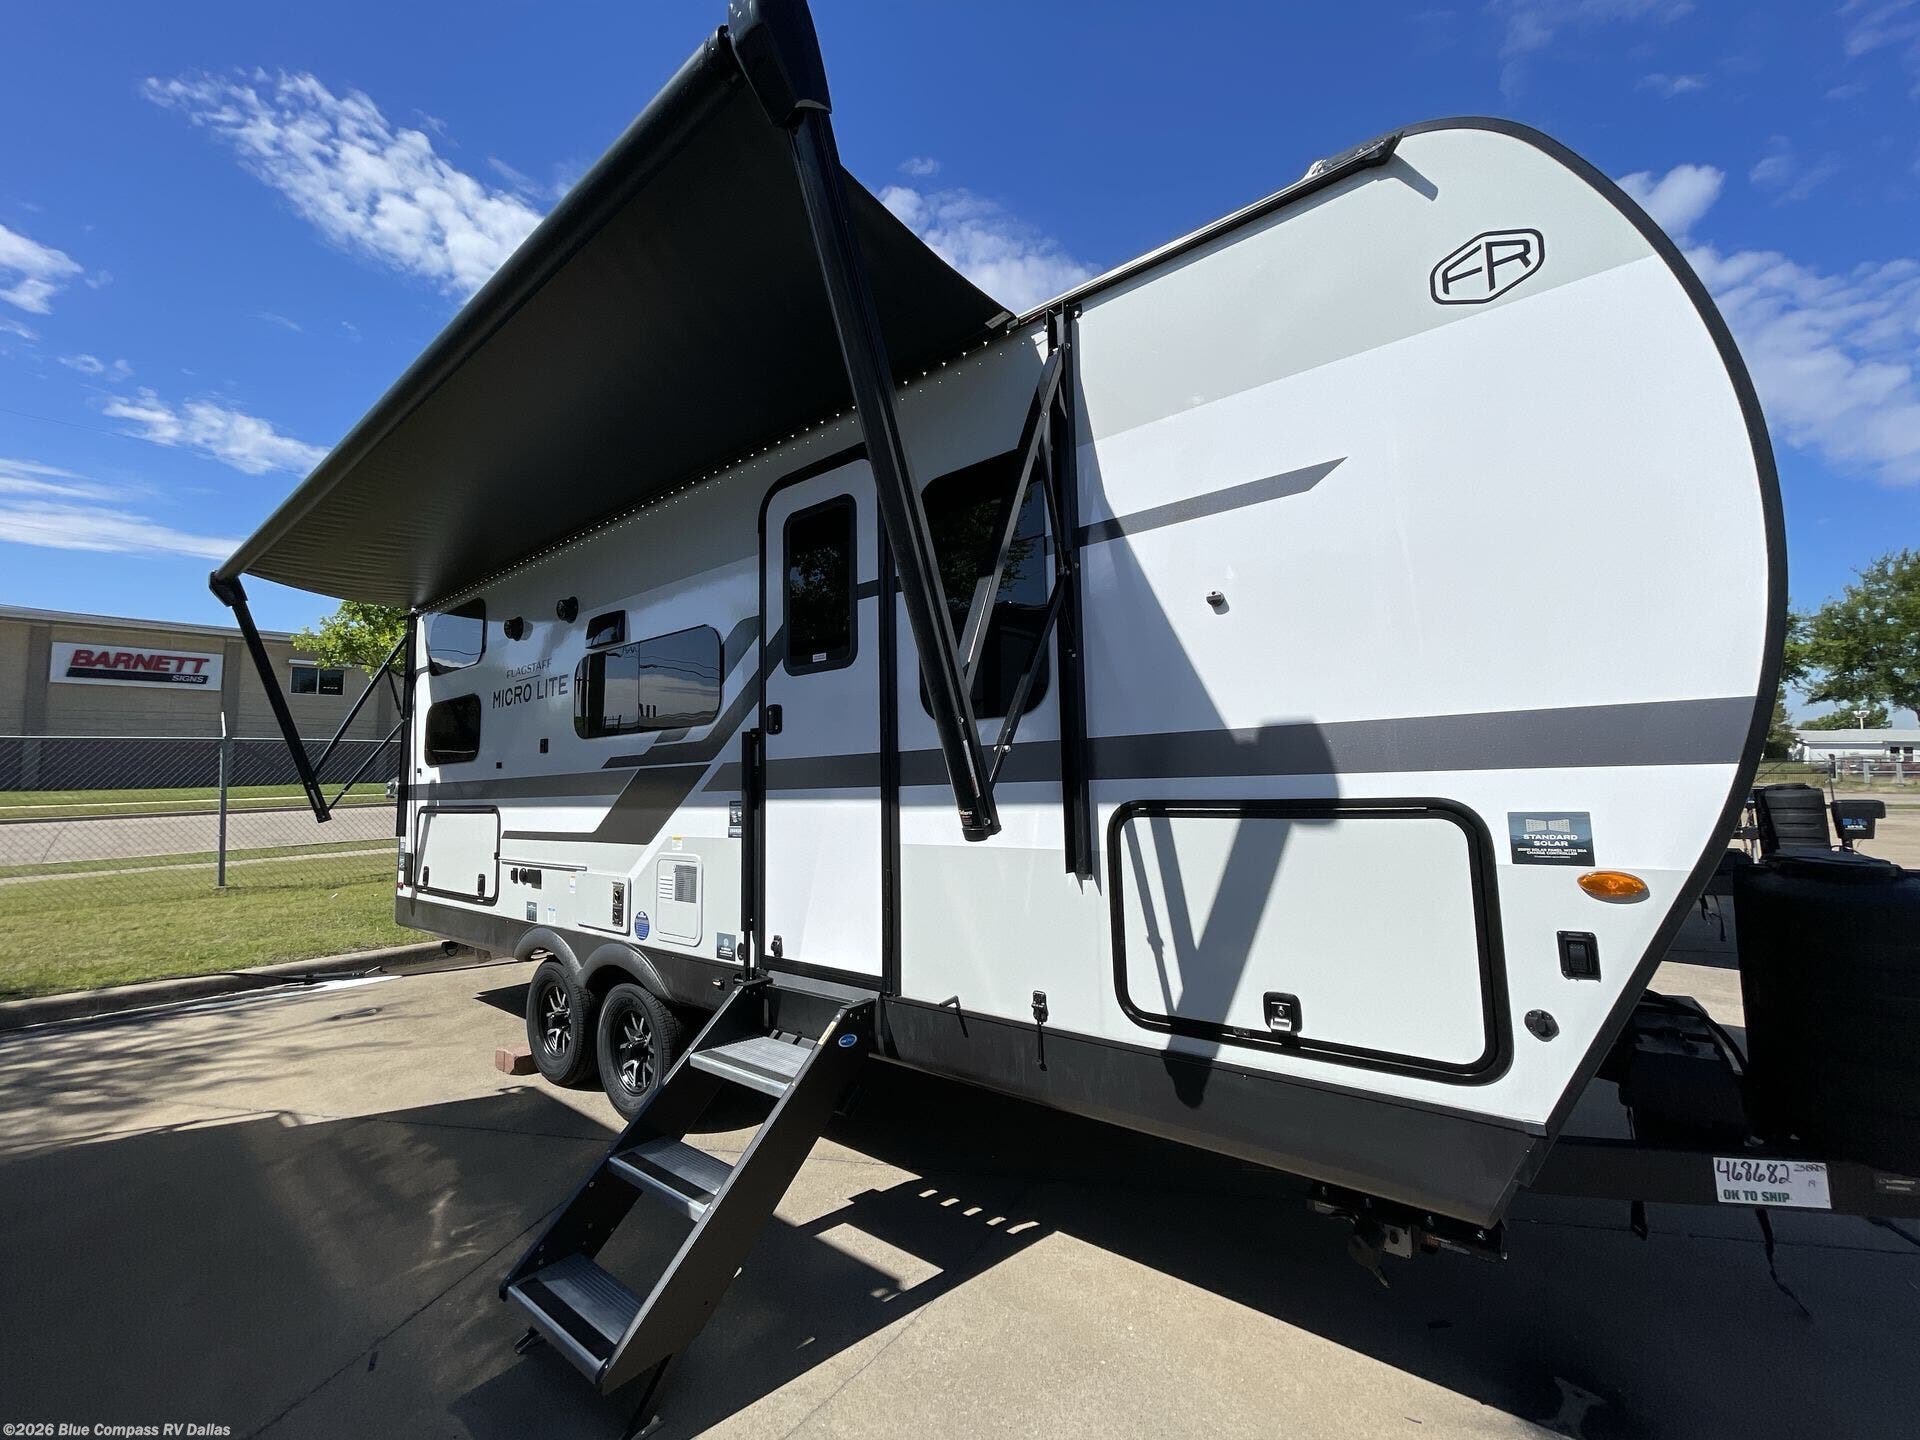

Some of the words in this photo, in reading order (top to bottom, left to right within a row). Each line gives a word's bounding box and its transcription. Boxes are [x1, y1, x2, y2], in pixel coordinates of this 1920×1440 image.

[70, 649, 210, 674] BARNETT
[506, 658, 552, 679] FLAGSTAFF
[171, 674, 204, 683] SIGNS
[492, 683, 532, 709] MICRO
[536, 673, 569, 700] LITE
[1716, 1159, 1793, 1184] 468682
[1723, 1189, 1741, 1200] OK
[1743, 1190, 1758, 1201] TO
[1761, 1191, 1790, 1203] SHIP
